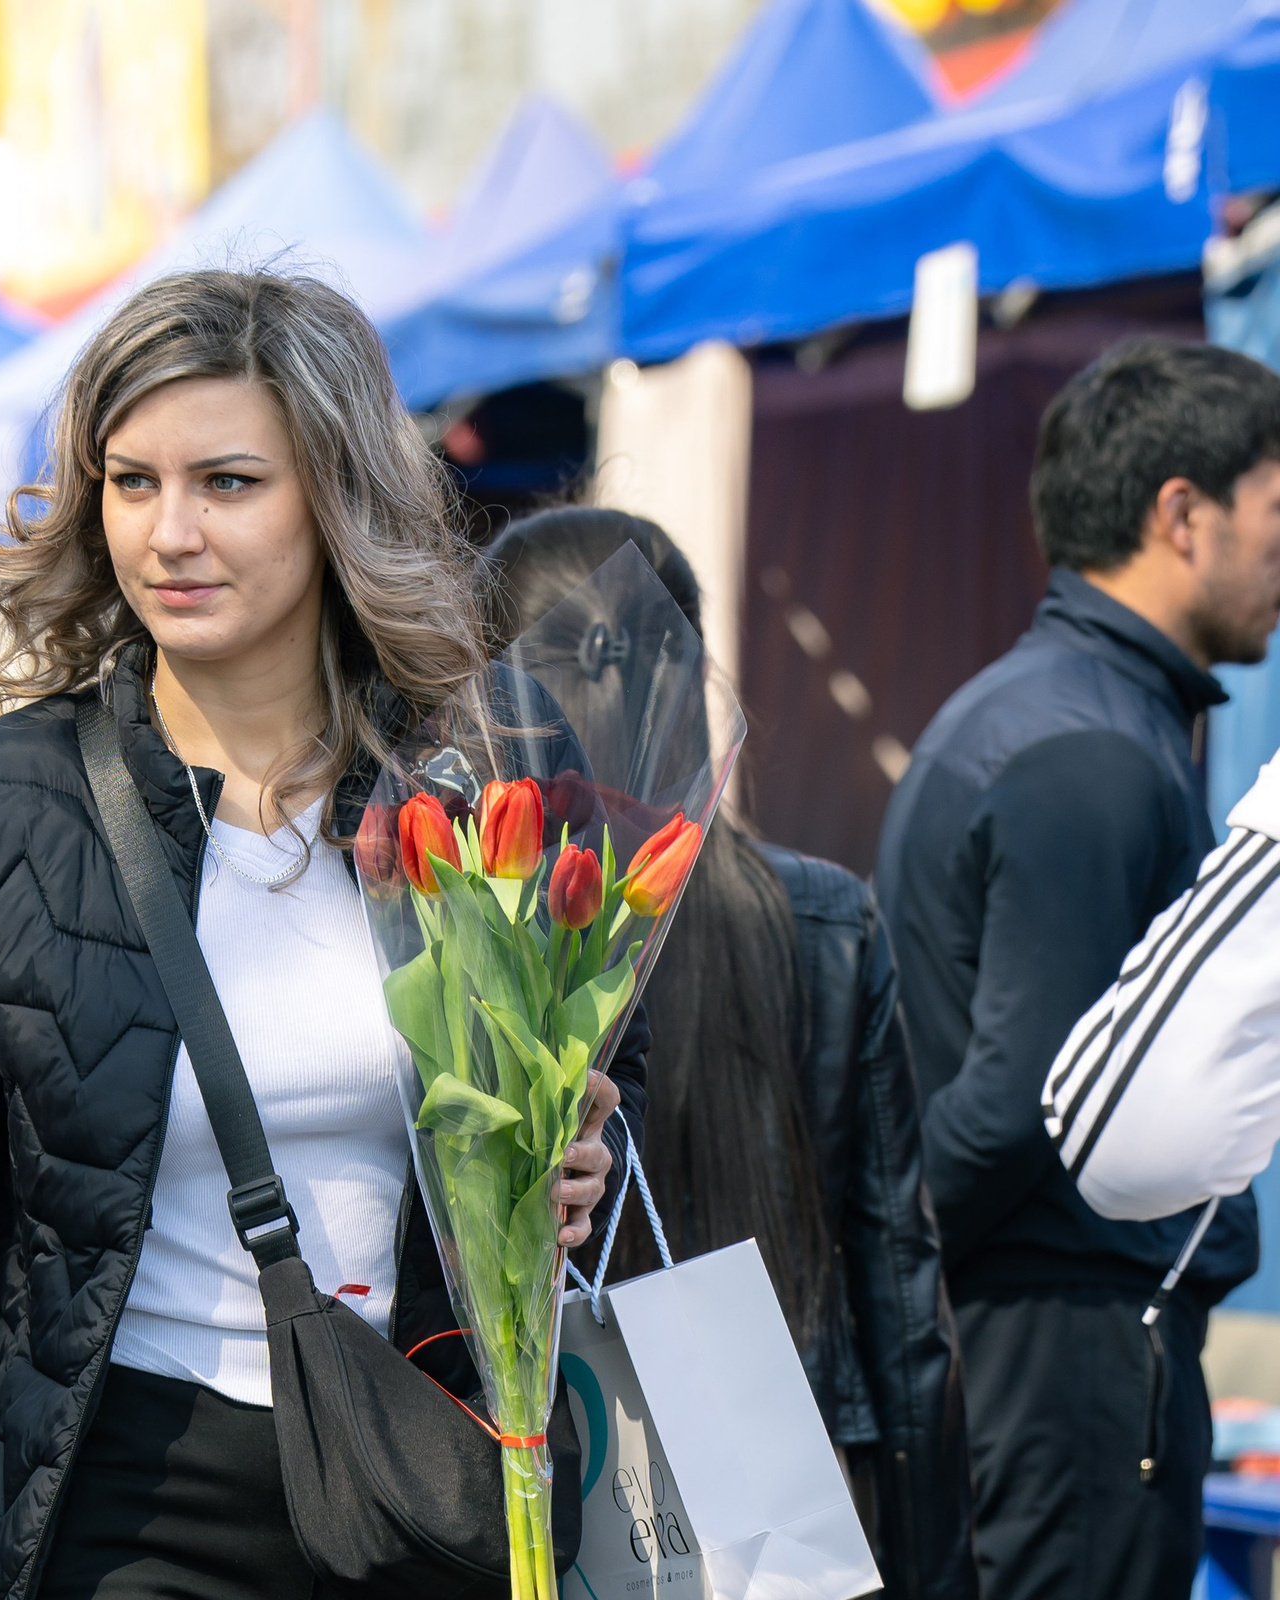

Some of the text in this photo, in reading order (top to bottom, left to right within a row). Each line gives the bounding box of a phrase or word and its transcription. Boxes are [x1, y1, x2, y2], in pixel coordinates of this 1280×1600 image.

[612, 1460, 665, 1513] evo
[629, 1511, 690, 1563] era
[674, 1568, 694, 1581] more
